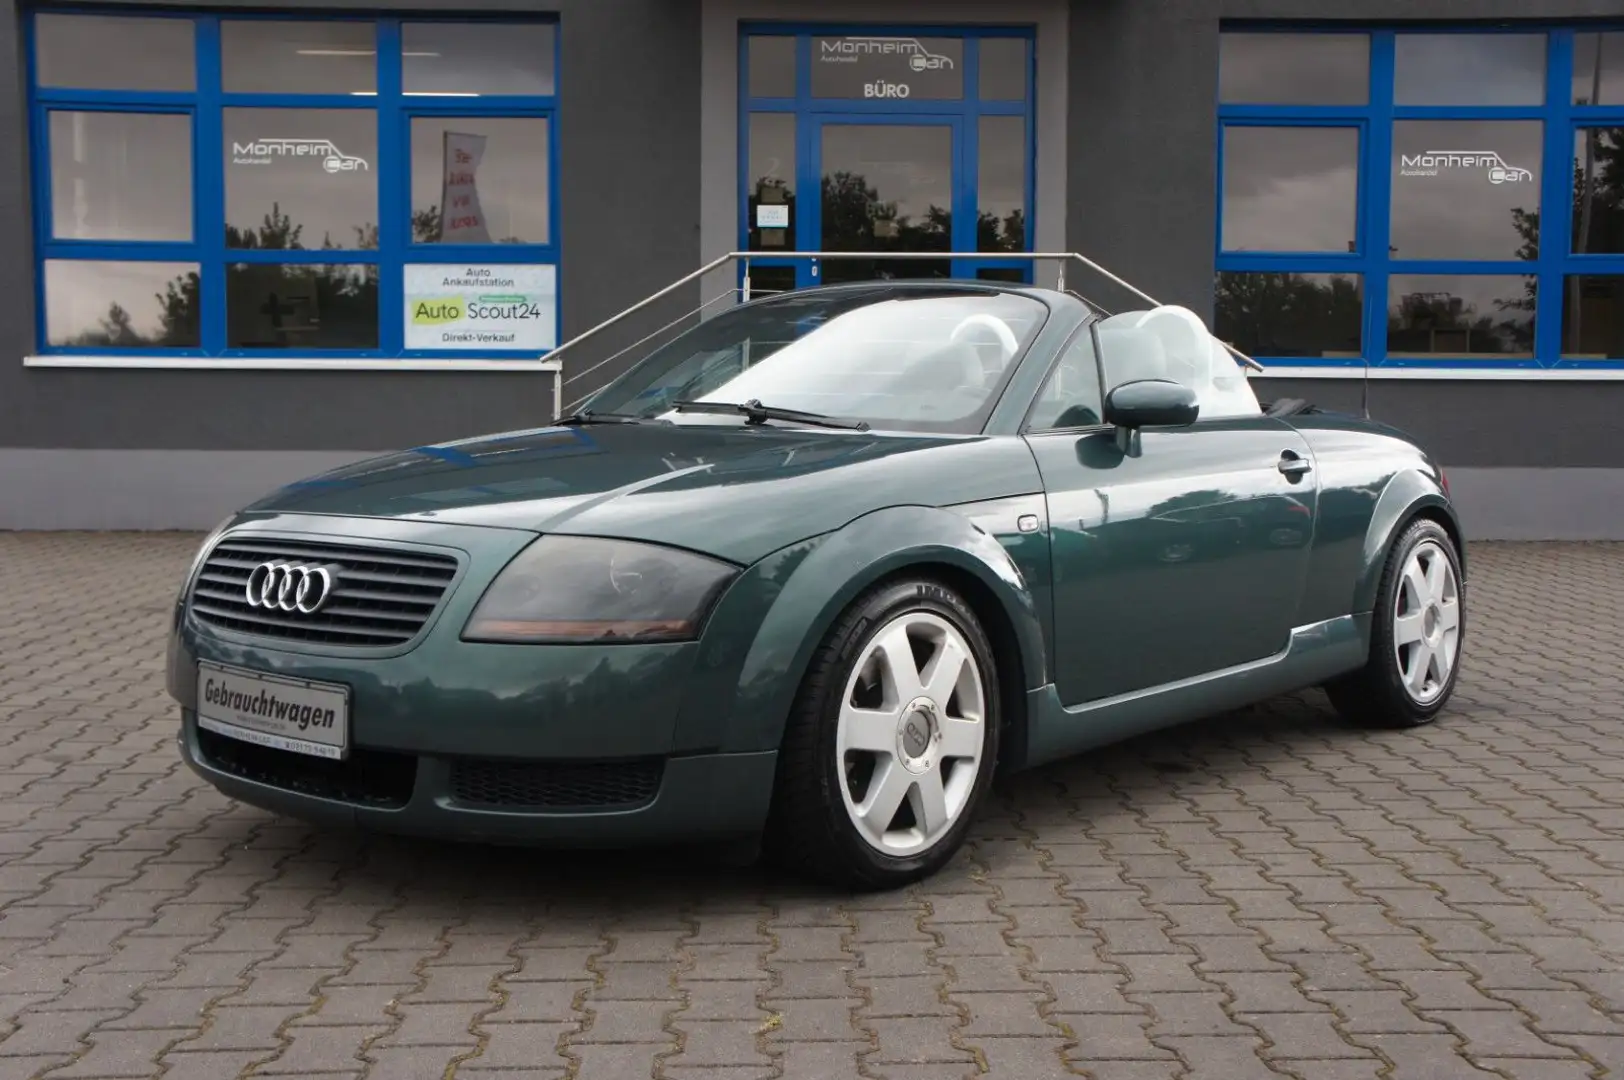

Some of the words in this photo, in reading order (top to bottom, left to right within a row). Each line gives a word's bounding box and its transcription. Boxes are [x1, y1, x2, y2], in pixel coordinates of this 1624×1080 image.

[821, 40, 918, 54] Monheim
[863, 80, 910, 98] BÜRO
[233, 142, 332, 156] Monheim
[1401, 154, 1498, 168] Monheim
[465, 268, 491, 277] Auto
[442, 277, 515, 288] Ankaufstation
[415, 302, 460, 319] Auto
[467, 302, 541, 319] Scout24
[442, 332, 515, 343] Direkt-Verkauf
[205, 678, 335, 731] Gebrauchtwagen
